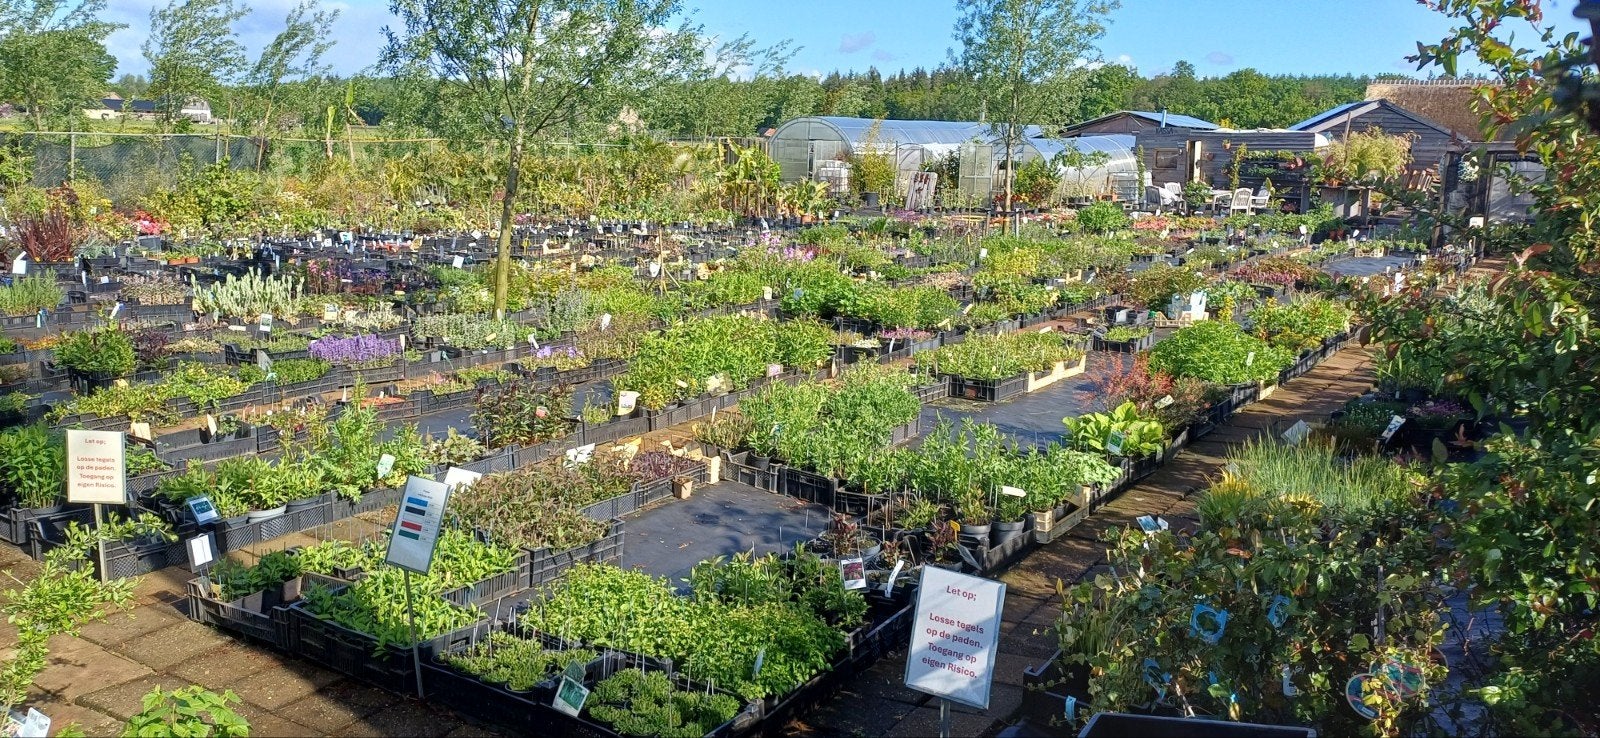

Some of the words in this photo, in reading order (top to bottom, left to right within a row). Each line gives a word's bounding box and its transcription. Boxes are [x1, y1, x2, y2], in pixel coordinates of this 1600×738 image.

[946, 585, 961, 596] Let
[962, 591, 977, 601] op;
[929, 612, 955, 626] Losse
[957, 620, 984, 634] tegels
[926, 628, 937, 637] op
[939, 630, 950, 640] de
[952, 634, 983, 649] paden.
[928, 642, 964, 661] Toegang
[965, 654, 977, 664] op
[922, 657, 946, 669] eigen
[947, 663, 978, 679] Risico.
